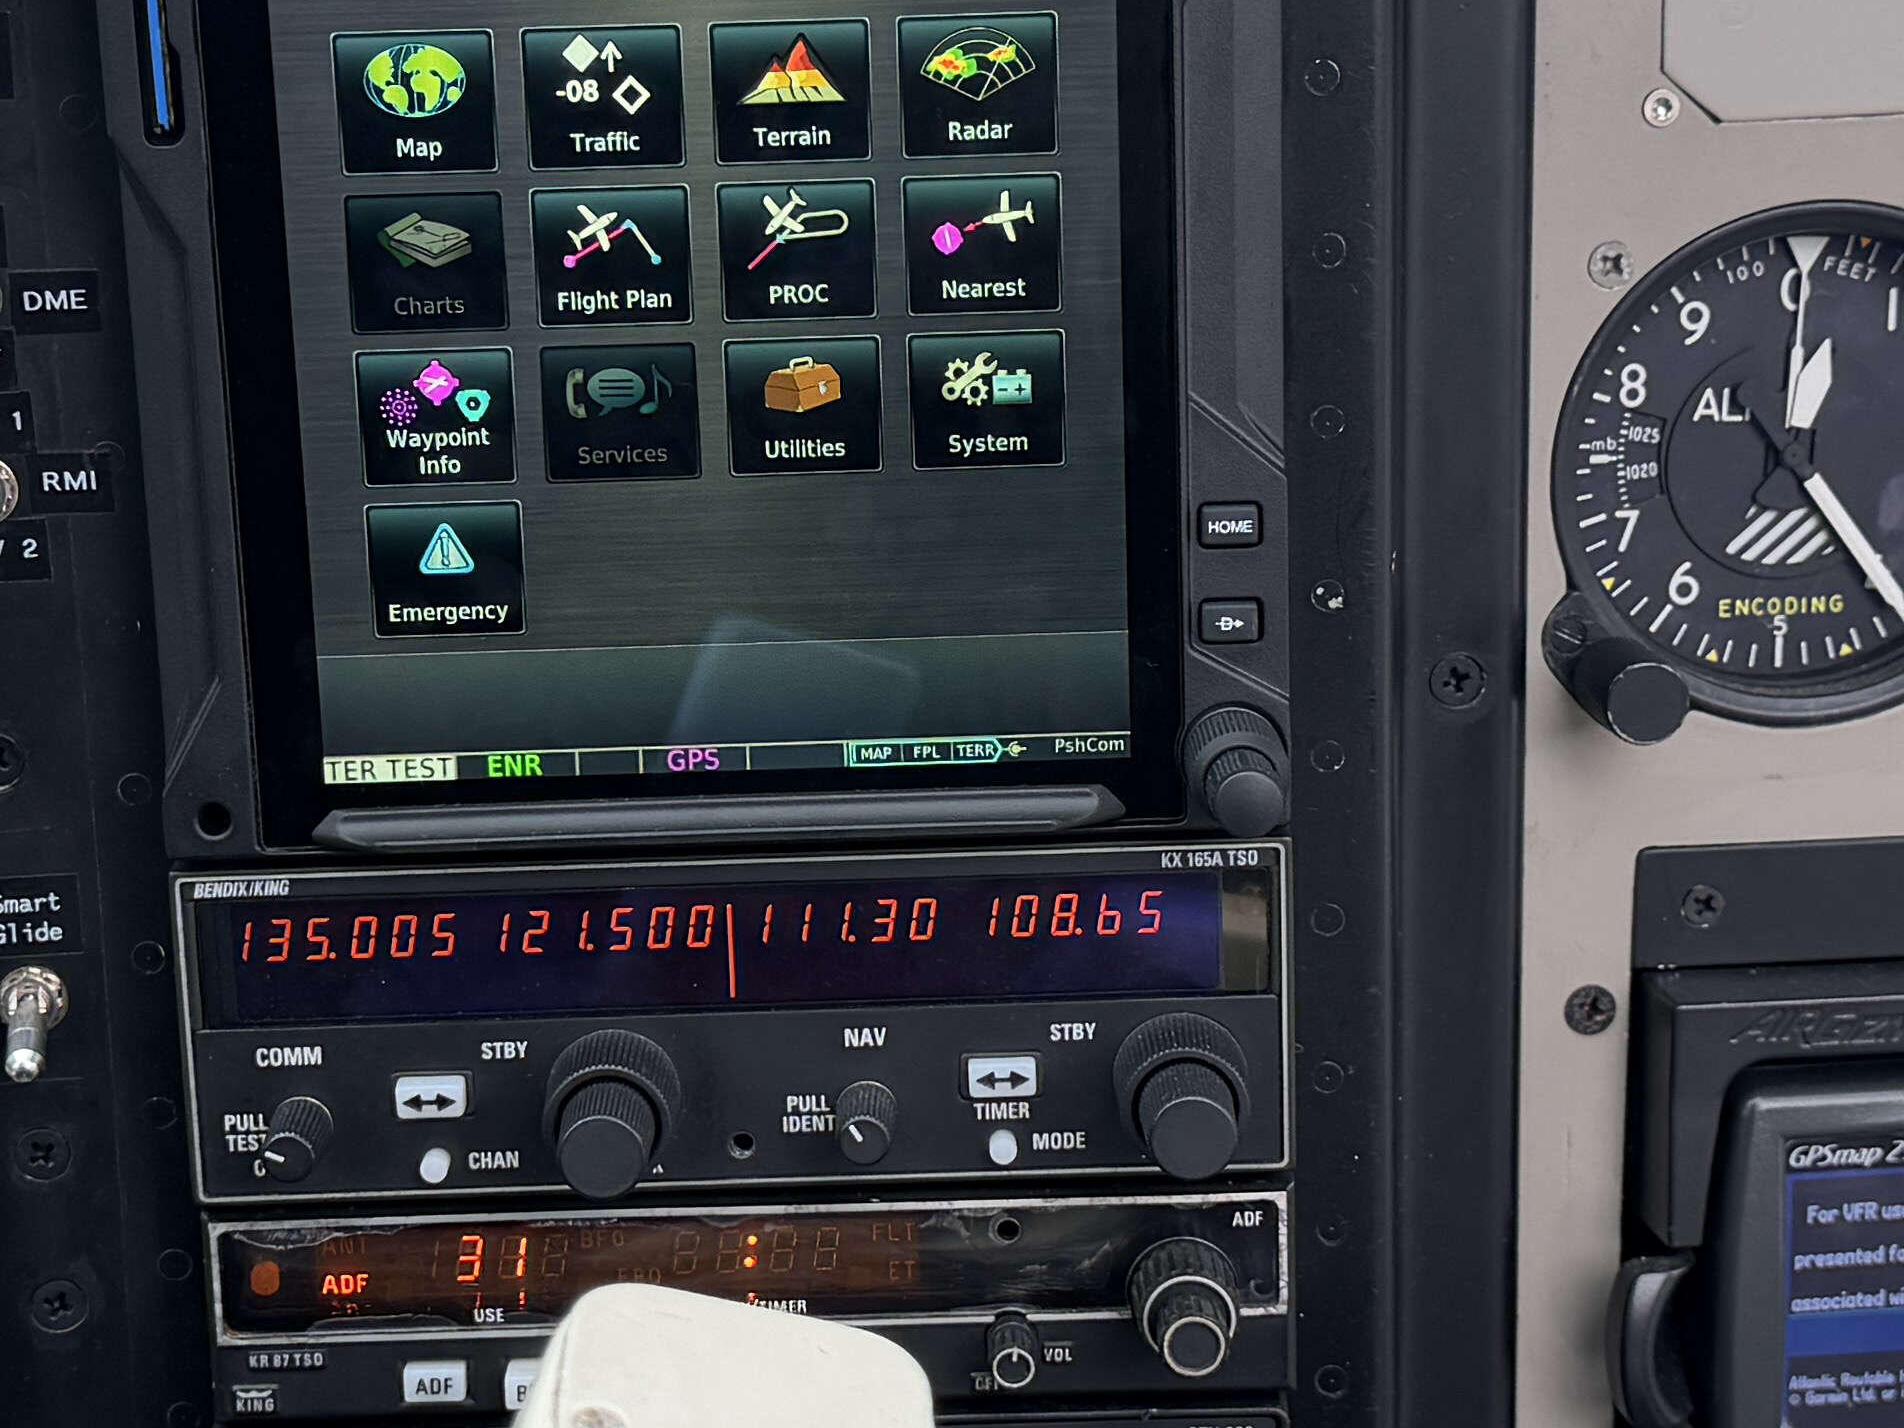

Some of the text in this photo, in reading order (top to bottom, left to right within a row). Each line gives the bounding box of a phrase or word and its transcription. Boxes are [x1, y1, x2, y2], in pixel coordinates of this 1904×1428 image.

[395, 135, 443, 162] Map
[570, 128, 641, 153] Traffic
[768, 283, 830, 307] PROC
[941, 276, 1027, 300] Nearest
[22, 289, 88, 312] DME
[385, 426, 490, 454] Waypoint
[764, 436, 846, 460] Utilities
[948, 430, 1029, 457] System
[418, 453, 461, 477] Info
[42, 470, 96, 492] RMI
[388, 599, 509, 626] Emergency
[1718, 596, 1844, 618] ENCODING
[1054, 735, 1126, 756] PshCom
[487, 753, 543, 778] ENR
[667, 748, 721, 772] GPS
[193, 879, 289, 899] BENDIX/KING
[989, 890, 1163, 938] 108.65
[241, 913, 456, 963] 135.005
[255, 1046, 322, 1068] COMM
[974, 1101, 1030, 1120] TIMER
[1032, 1131, 1086, 1151] MODE
[468, 1151, 519, 1171] CHAN
[1788, 1144, 1882, 1168] GPSmap
[322, 1274, 369, 1295] ADF
